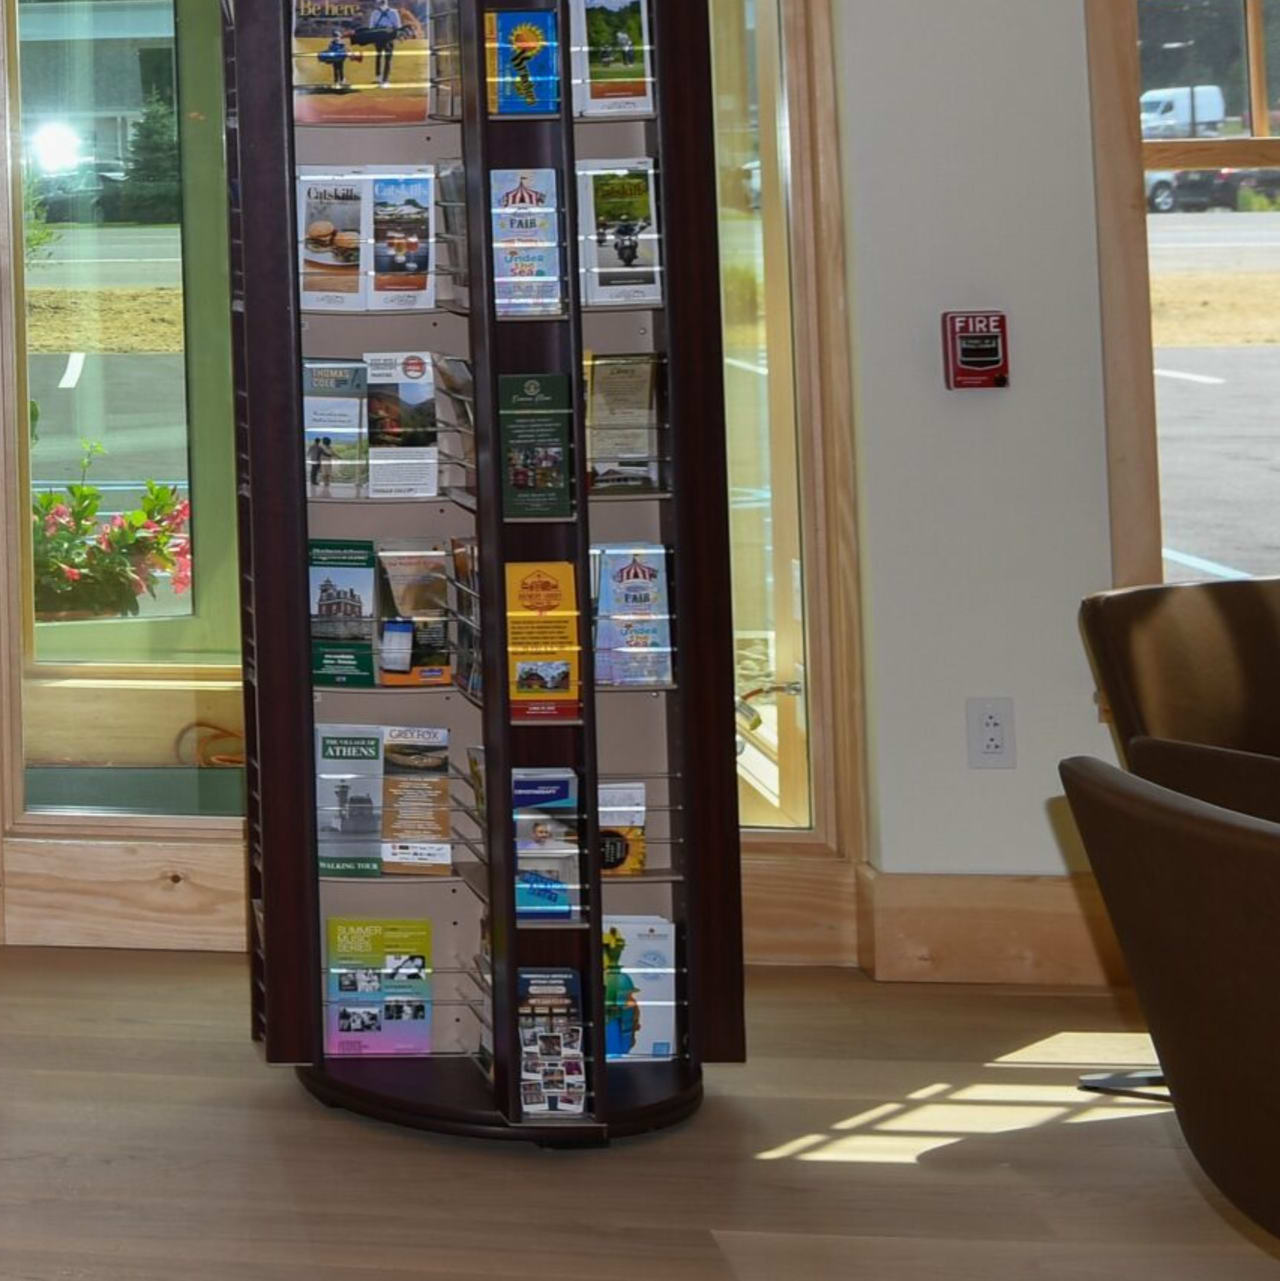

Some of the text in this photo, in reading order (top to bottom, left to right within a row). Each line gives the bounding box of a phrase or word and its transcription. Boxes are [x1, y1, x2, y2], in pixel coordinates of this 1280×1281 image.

[300, 0, 321, 16] Be
[509, 218, 537, 230] FAIR
[955, 316, 1001, 333] FIRE
[325, 746, 376, 757] ATHENS
[319, 862, 379, 870] WALKING TOUR
[337, 925, 382, 935] SUMMER
